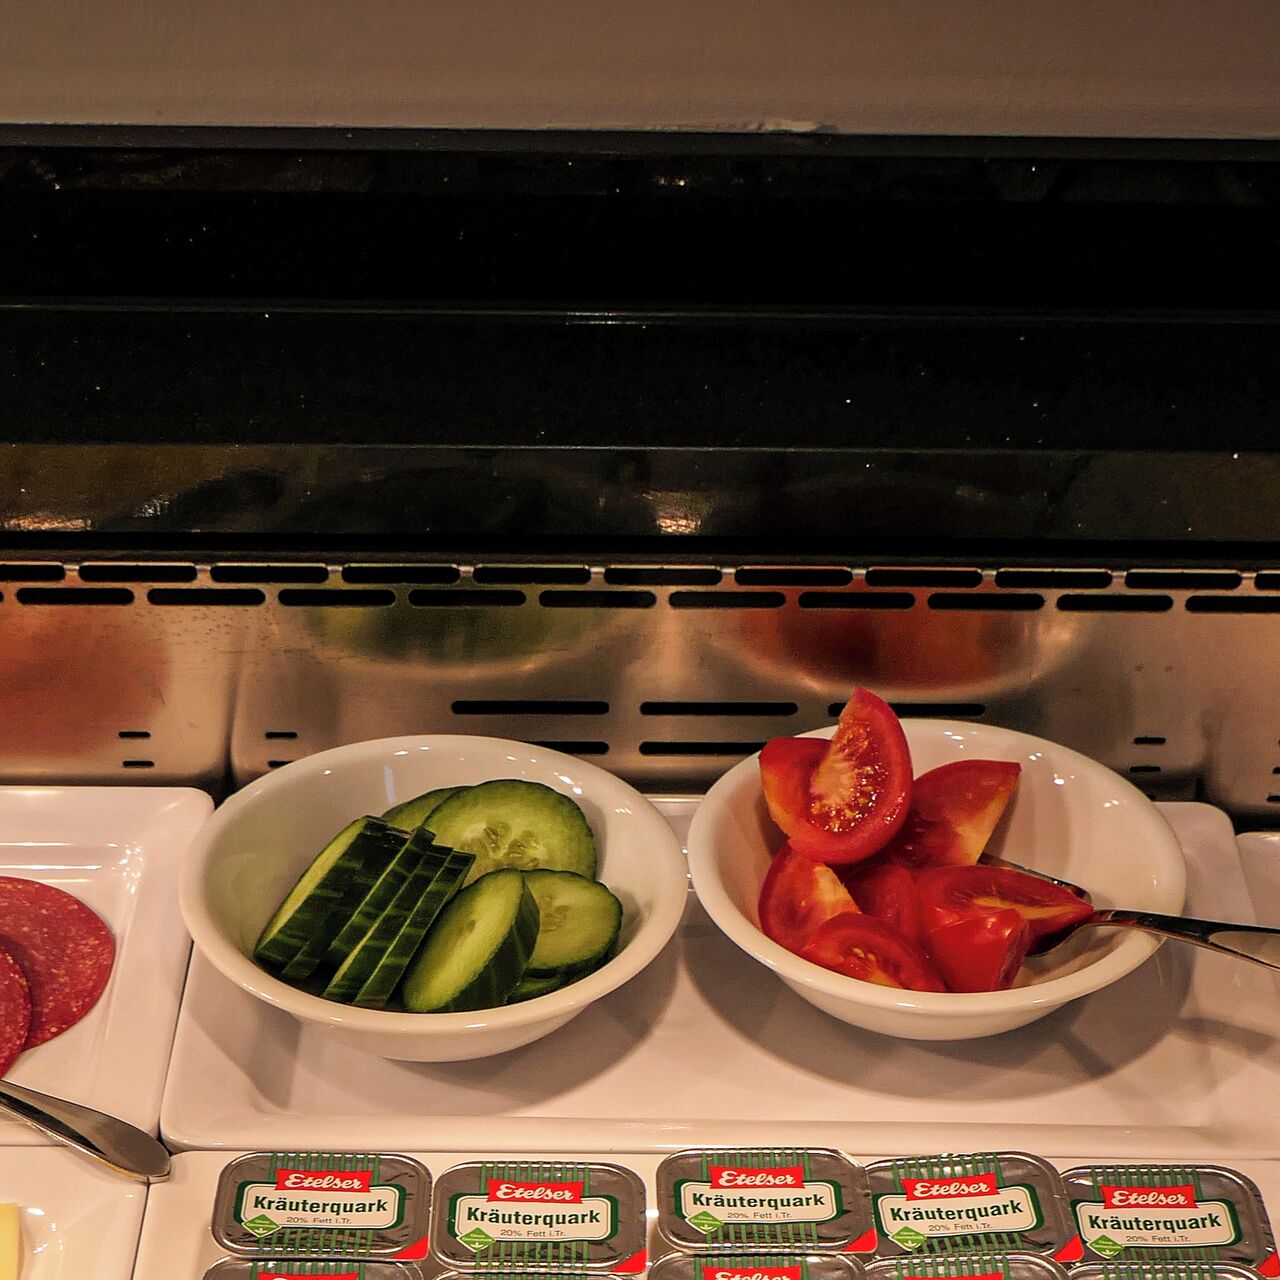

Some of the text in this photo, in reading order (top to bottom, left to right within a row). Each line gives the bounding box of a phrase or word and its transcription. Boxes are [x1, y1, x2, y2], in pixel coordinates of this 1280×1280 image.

[284, 1174, 363, 1190] Etelser
[718, 1171, 795, 1186] Etelser
[496, 1184, 573, 1201] Etelser
[913, 1180, 990, 1198] Etelser
[254, 1196, 387, 1215] Kräuterquark
[693, 1192, 825, 1210] Kräuterquark
[1112, 1190, 1188, 1207] Etelser
[286, 1216, 308, 1224] 20%
[313, 1216, 332, 1224] Fett
[467, 1207, 600, 1228] Kräuterquark
[727, 1211, 749, 1219] 20%
[753, 1211, 772, 1219] Fett
[891, 1200, 1023, 1223] Kräuterquark
[928, 1223, 950, 1231] 20%
[954, 1223, 972, 1231] Fett
[1089, 1213, 1222, 1233] Kräuterquark
